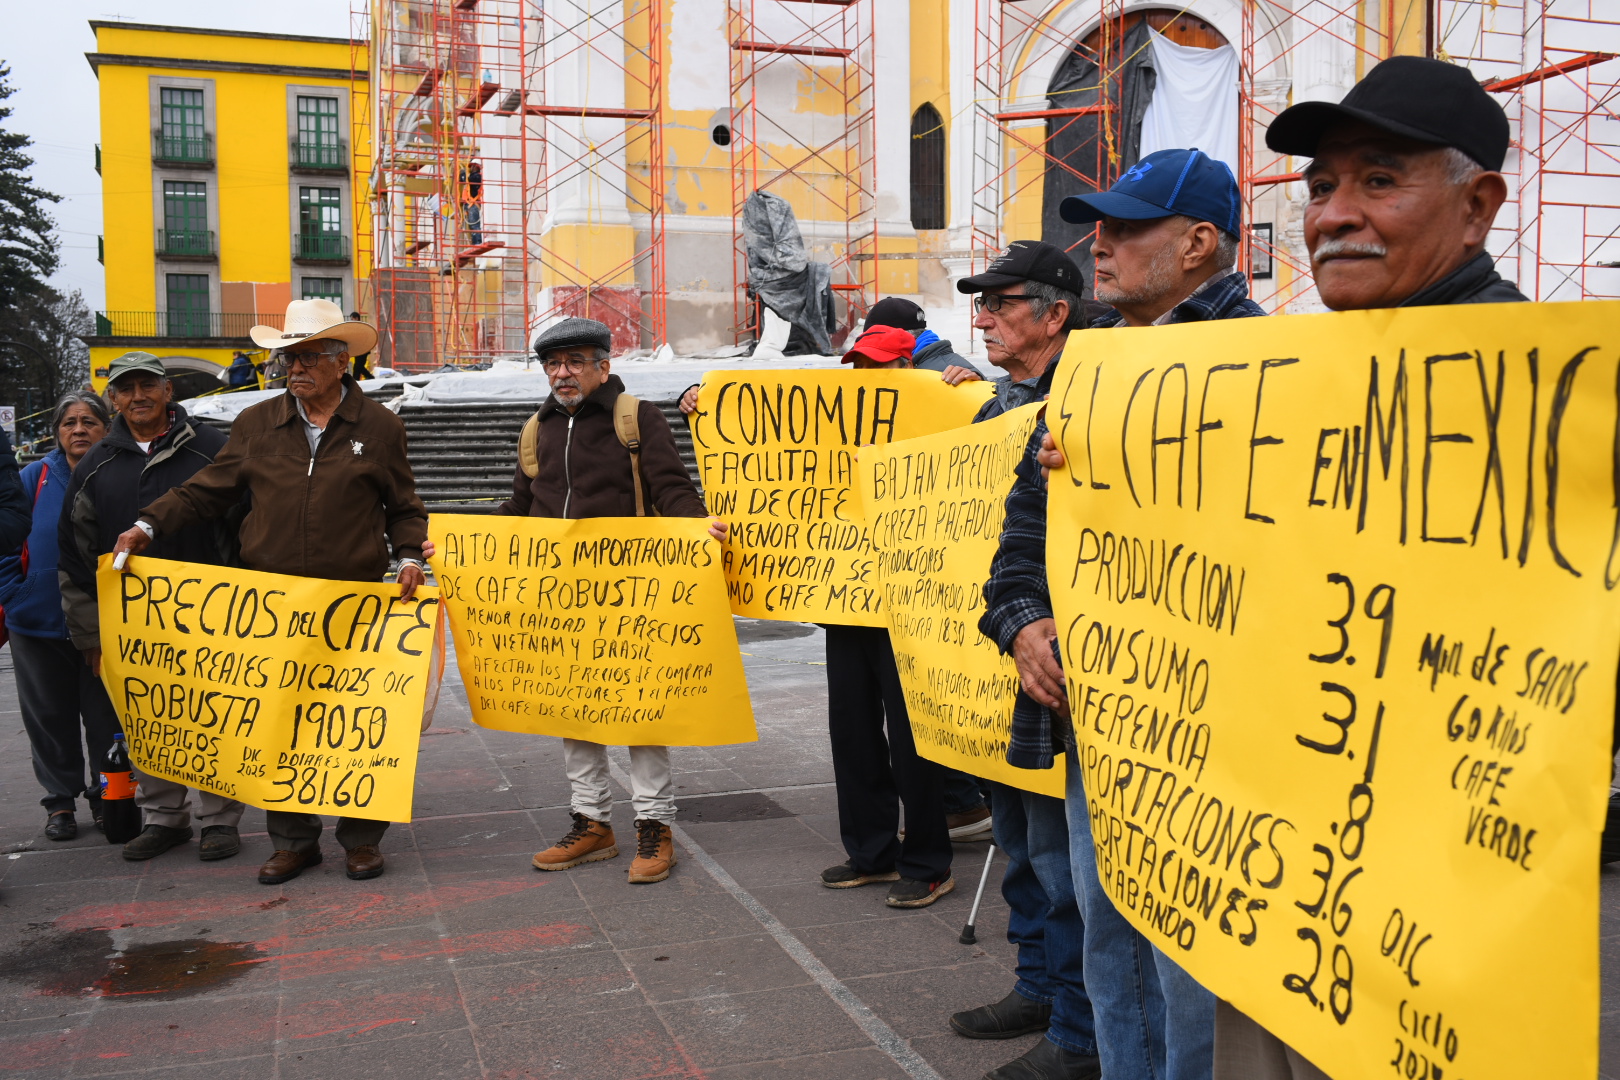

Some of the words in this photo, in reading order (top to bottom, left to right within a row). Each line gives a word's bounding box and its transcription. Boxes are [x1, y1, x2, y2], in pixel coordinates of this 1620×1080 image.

[694, 381, 899, 448] ECONOMIA
[1059, 359, 1111, 490] EL
[1121, 357, 1300, 524] CAFE
[1308, 426, 1361, 510] EN
[704, 449, 818, 486] FACILITA
[873, 451, 941, 504] BAJAN
[787, 486, 851, 524] CAFE
[872, 504, 928, 552] CEREZA
[443, 532, 497, 569] ALTO
[508, 534, 520, 570] A
[572, 536, 712, 569] IMPORTACIONES
[728, 521, 799, 550] MENOR
[738, 552, 836, 586] MAYORIA
[845, 558, 874, 585] SE
[878, 545, 947, 581] PRODUCTORES
[121, 572, 286, 638] PRECIOS
[286, 610, 319, 638] DEL
[322, 592, 439, 657] CAFE
[441, 573, 467, 602] DE
[475, 575, 528, 605] CAFE
[537, 574, 660, 611] ROBUSTA
[671, 579, 698, 606] DE
[765, 583, 819, 612] CAFE
[1071, 527, 1246, 636] PRODUCCION
[1308, 572, 1396, 679] 3.9
[466, 605, 512, 629] MENOR
[598, 614, 608, 637] Y
[616, 613, 705, 647] PRECIOS
[466, 629, 484, 649] DE
[491, 632, 565, 658] VIETNAM
[570, 637, 580, 662] Y
[118, 633, 187, 676] VENTAS
[382, 670, 415, 696] OIC
[473, 655, 534, 675] AFECTAN
[569, 664, 631, 686] PRECIOS
[656, 662, 714, 685] COMPRA
[124, 676, 261, 738] ROBUSTA
[501, 699, 531, 716] CAFE
[539, 702, 556, 718] DE
[560, 703, 667, 725] EXPORTACION
[511, 676, 624, 703] PRODUCTORES
[665, 684, 709, 701] PRECIO
[1066, 613, 1210, 718] CONSUMO
[1295, 681, 1385, 783] 3.1
[125, 712, 222, 757] ARABIGOS
[1068, 673, 1211, 783] DIFERENCIA
[1446, 694, 1482, 743] 60
[237, 762, 266, 778] 2025
[262, 765, 375, 808] 381.60
[1451, 754, 1514, 807] CAFE
[1074, 730, 1298, 890] XPORTACIONES
[1294, 843, 1364, 938] 3.6
[1464, 805, 1538, 872] VERDE
[1088, 799, 1269, 947] PORTACIONES
[1282, 927, 1354, 1026] 2.8
